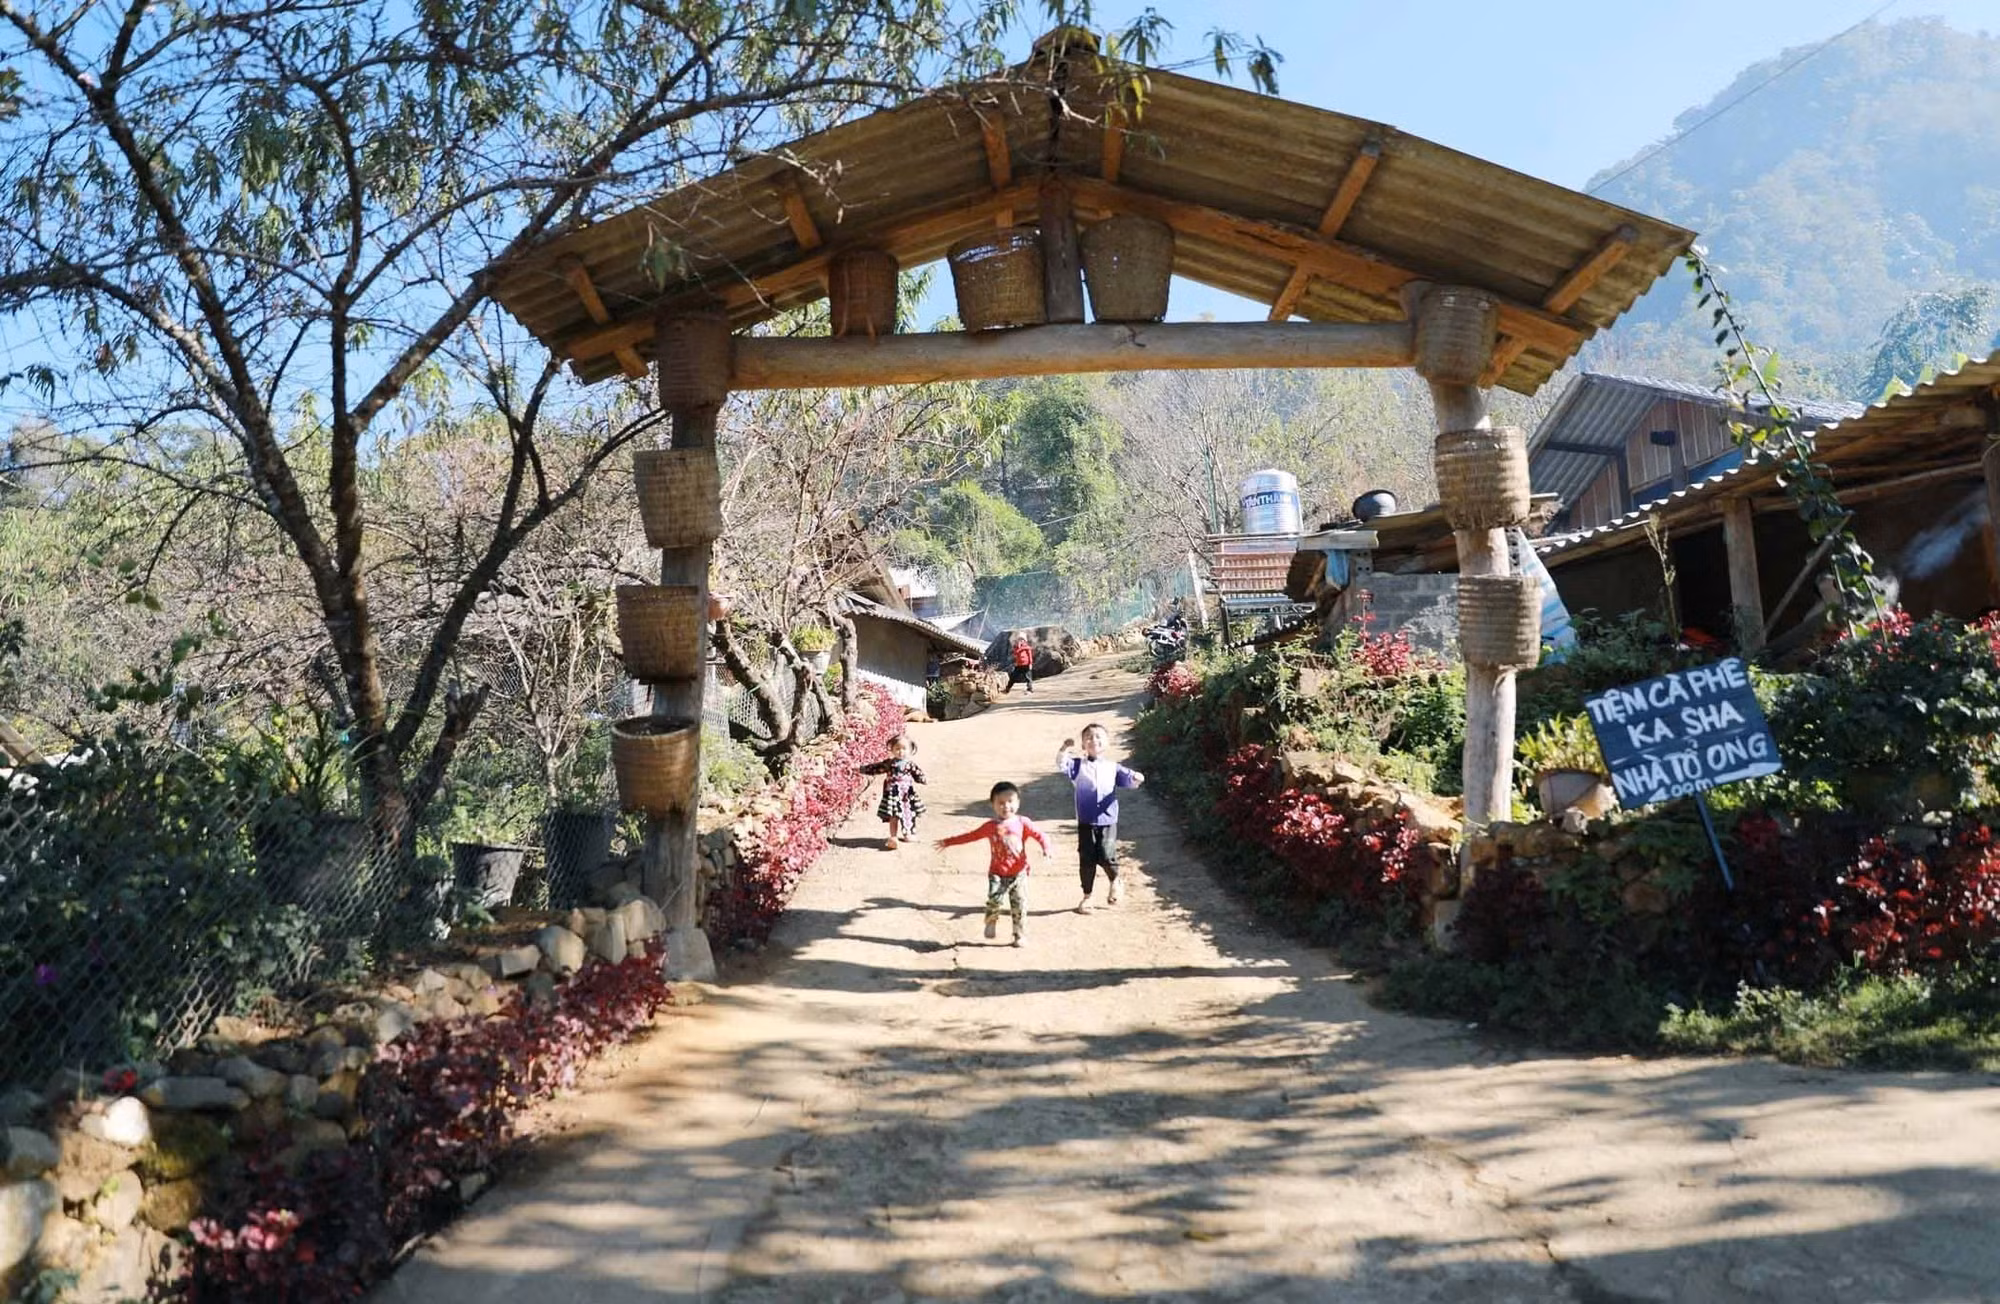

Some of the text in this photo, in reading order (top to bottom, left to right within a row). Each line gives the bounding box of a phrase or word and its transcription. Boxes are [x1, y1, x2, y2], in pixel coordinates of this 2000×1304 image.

[1585, 657, 1747, 724] TIỆM CÀ PHÊ
[1627, 700, 1745, 748] KA SHA
[1611, 754, 1671, 799] NHÀ
[1706, 733, 1767, 770] ONG
